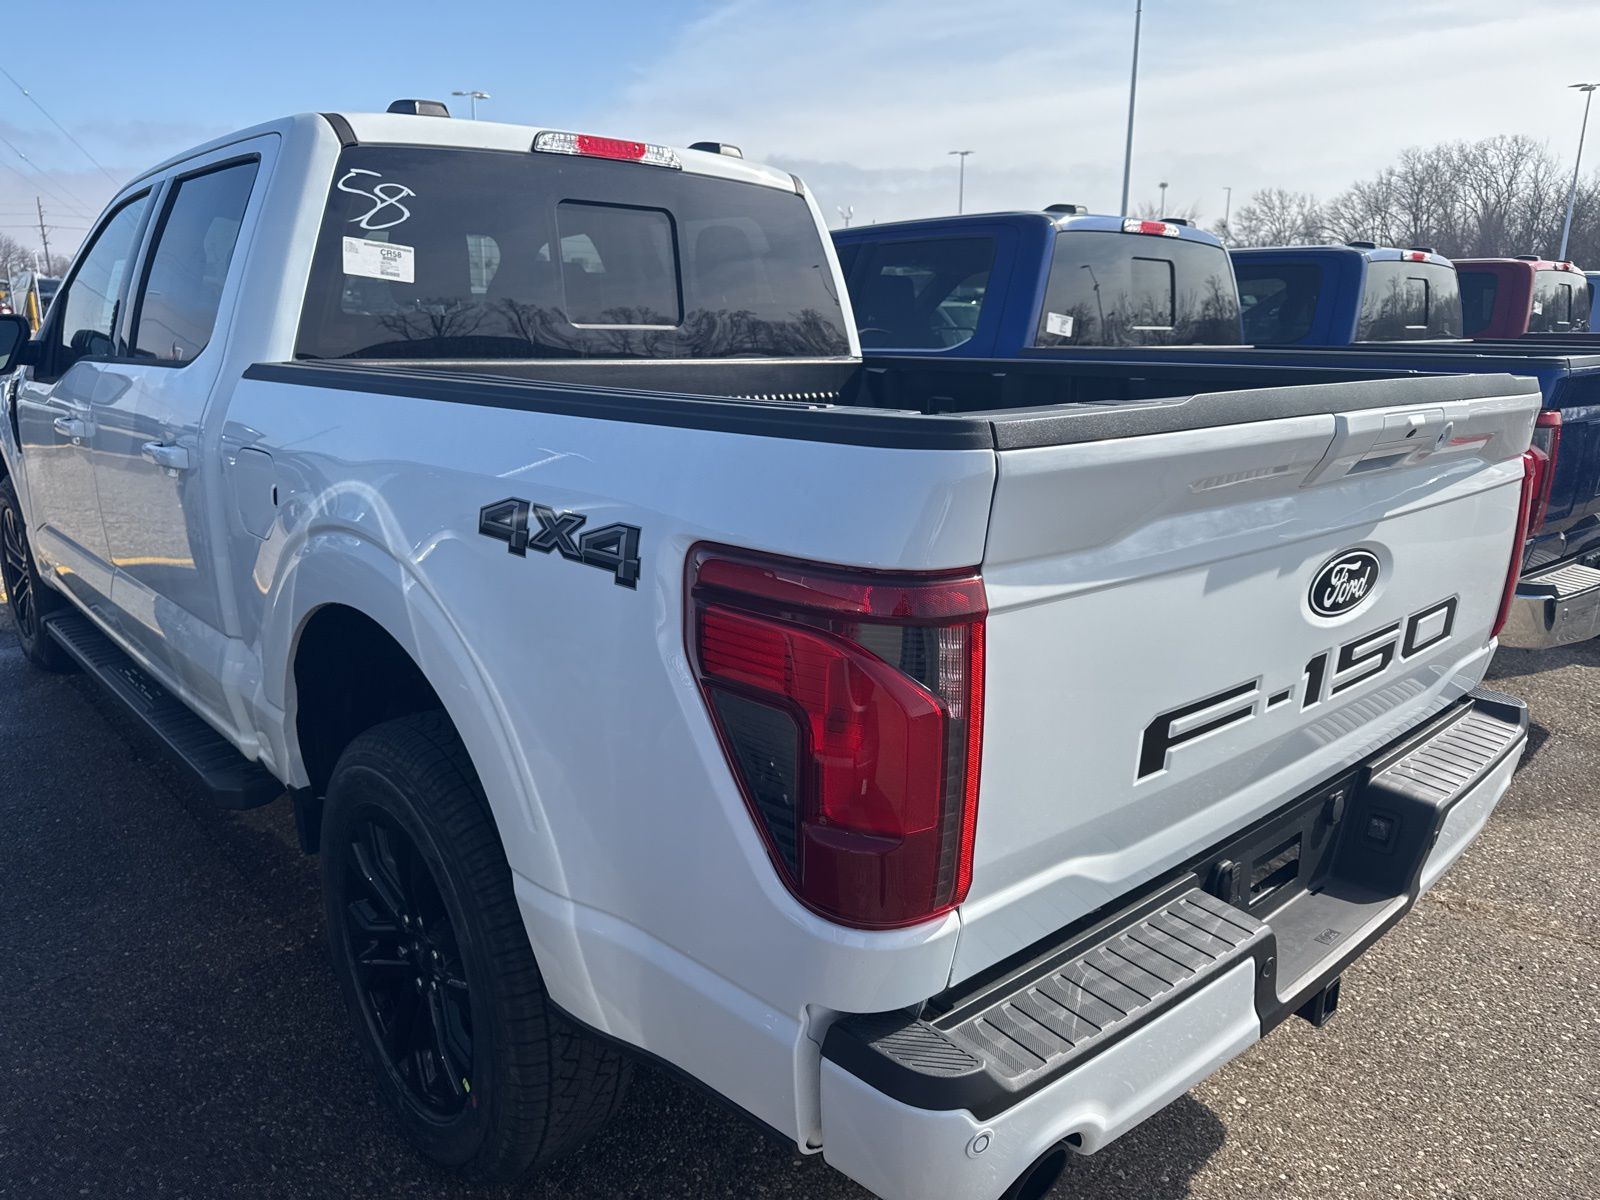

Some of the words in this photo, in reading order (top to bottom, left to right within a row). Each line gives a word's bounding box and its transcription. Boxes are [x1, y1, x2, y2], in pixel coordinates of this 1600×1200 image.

[337, 168, 416, 230] 58
[1321, 558, 1373, 609] Ford
[1134, 594, 1459, 785] F-150
